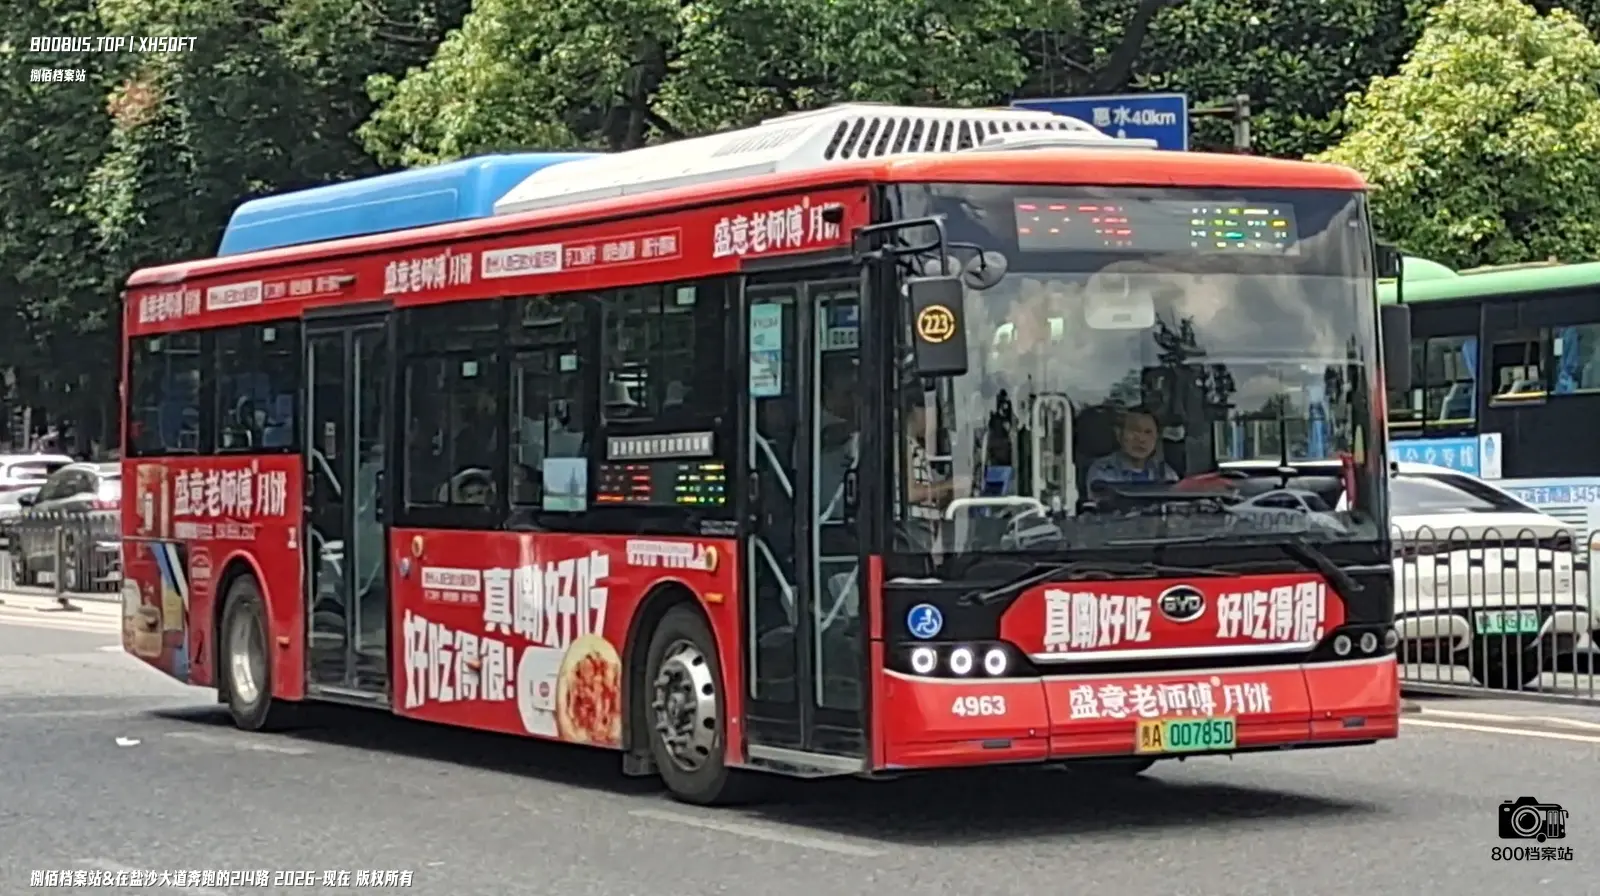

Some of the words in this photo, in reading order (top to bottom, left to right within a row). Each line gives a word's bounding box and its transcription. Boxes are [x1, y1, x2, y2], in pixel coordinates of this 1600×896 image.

[924, 314, 948, 334] 223
[174, 465, 287, 519] 盛意老师傅月饼
[1164, 596, 1200, 611] BYD
[1216, 581, 1325, 641] 好吃得很!
[403, 608, 514, 709] 好吃得很!
[951, 695, 1006, 716] 4963
[1069, 679, 1272, 719] 盛意老师傅月饼
